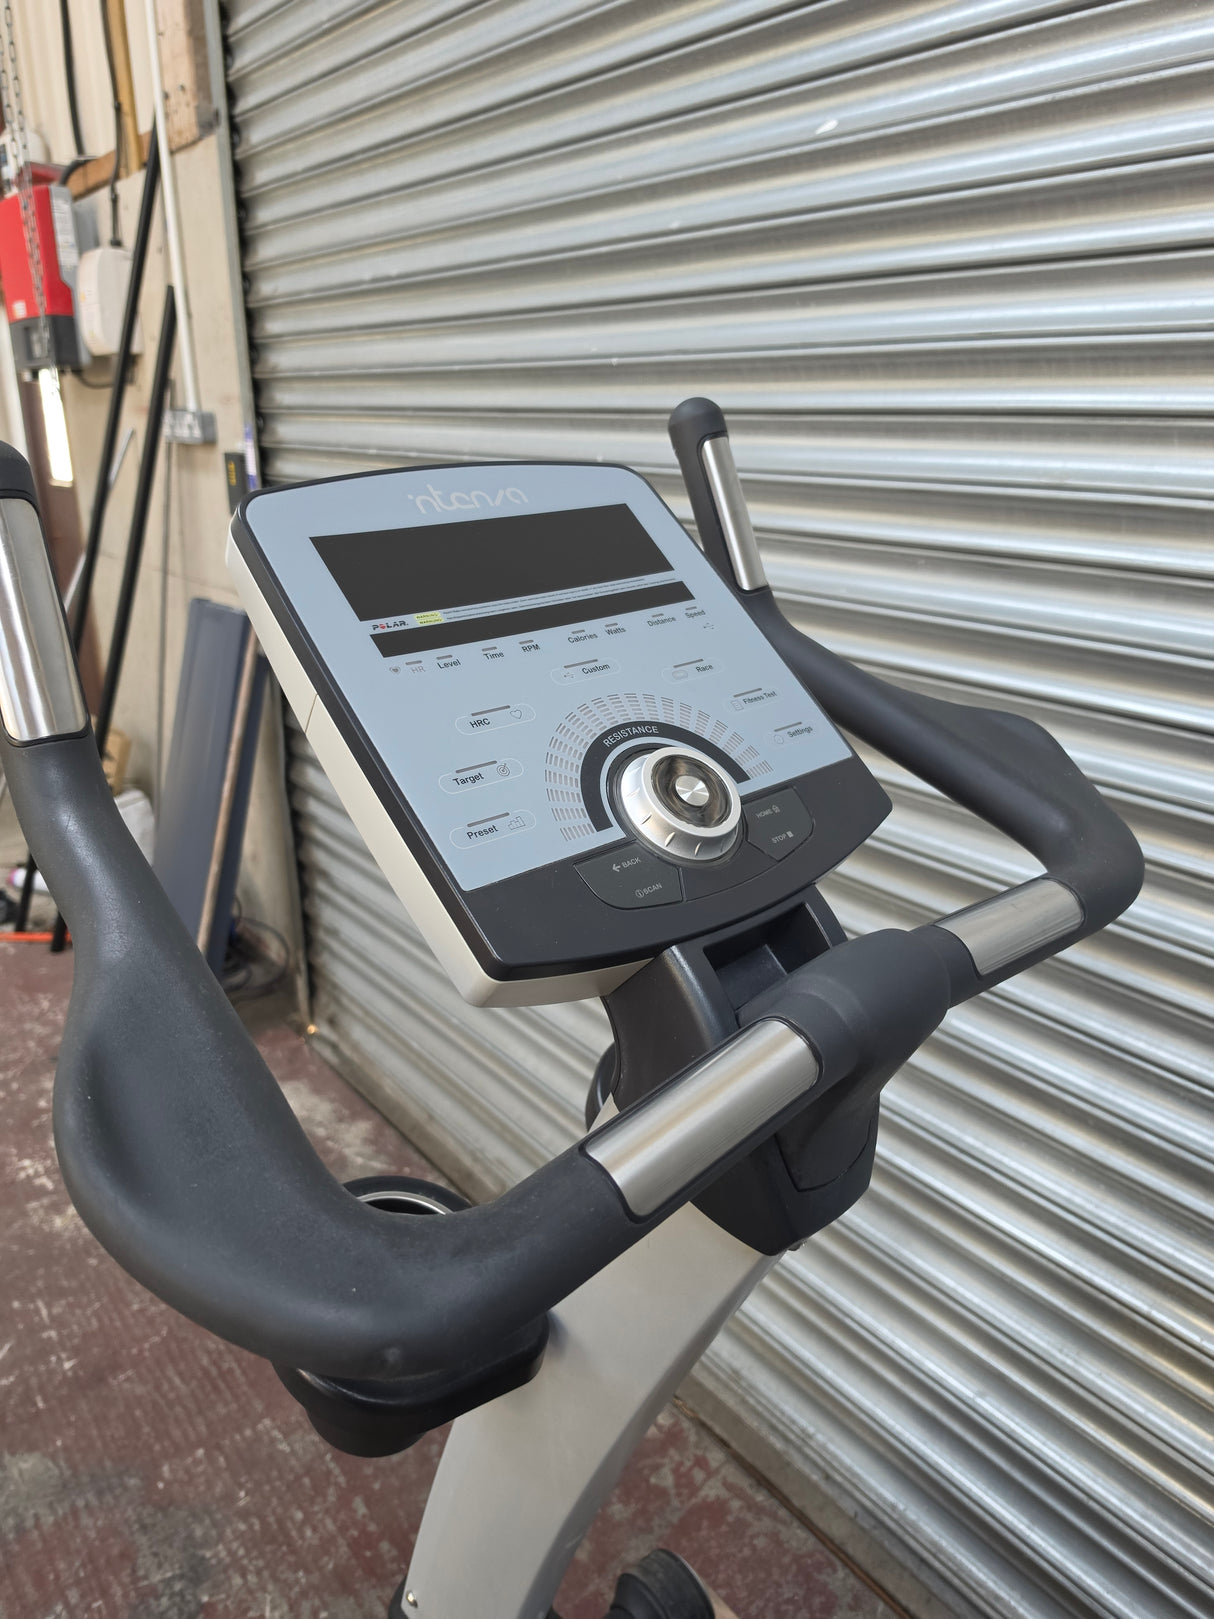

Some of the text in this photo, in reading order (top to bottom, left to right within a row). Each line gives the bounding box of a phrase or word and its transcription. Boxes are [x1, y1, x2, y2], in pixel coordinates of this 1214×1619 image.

[684, 609, 706, 619] Speed
[647, 615, 676, 627] Distance
[605, 625, 626, 636] Watts
[567, 632, 598, 644] Calories
[521, 643, 541, 653] RPM
[483, 651, 505, 661] Time
[411, 665, 426, 674] HR
[437, 658, 461, 669] Level
[582, 663, 610, 675] Custom
[695, 664, 714, 673] Race
[742, 690, 777, 705] Fitness Test
[469, 717, 491, 729] HRC
[602, 725, 659, 748] RESISTANCE
[786, 725, 813, 738] Settings
[453, 772, 484, 786] Target
[755, 808, 773, 818] HOME
[466, 824, 499, 840] Preset
[771, 833, 787, 844] STOP
[621, 856, 642, 869] BACK
[643, 882, 663, 895] SCAN
